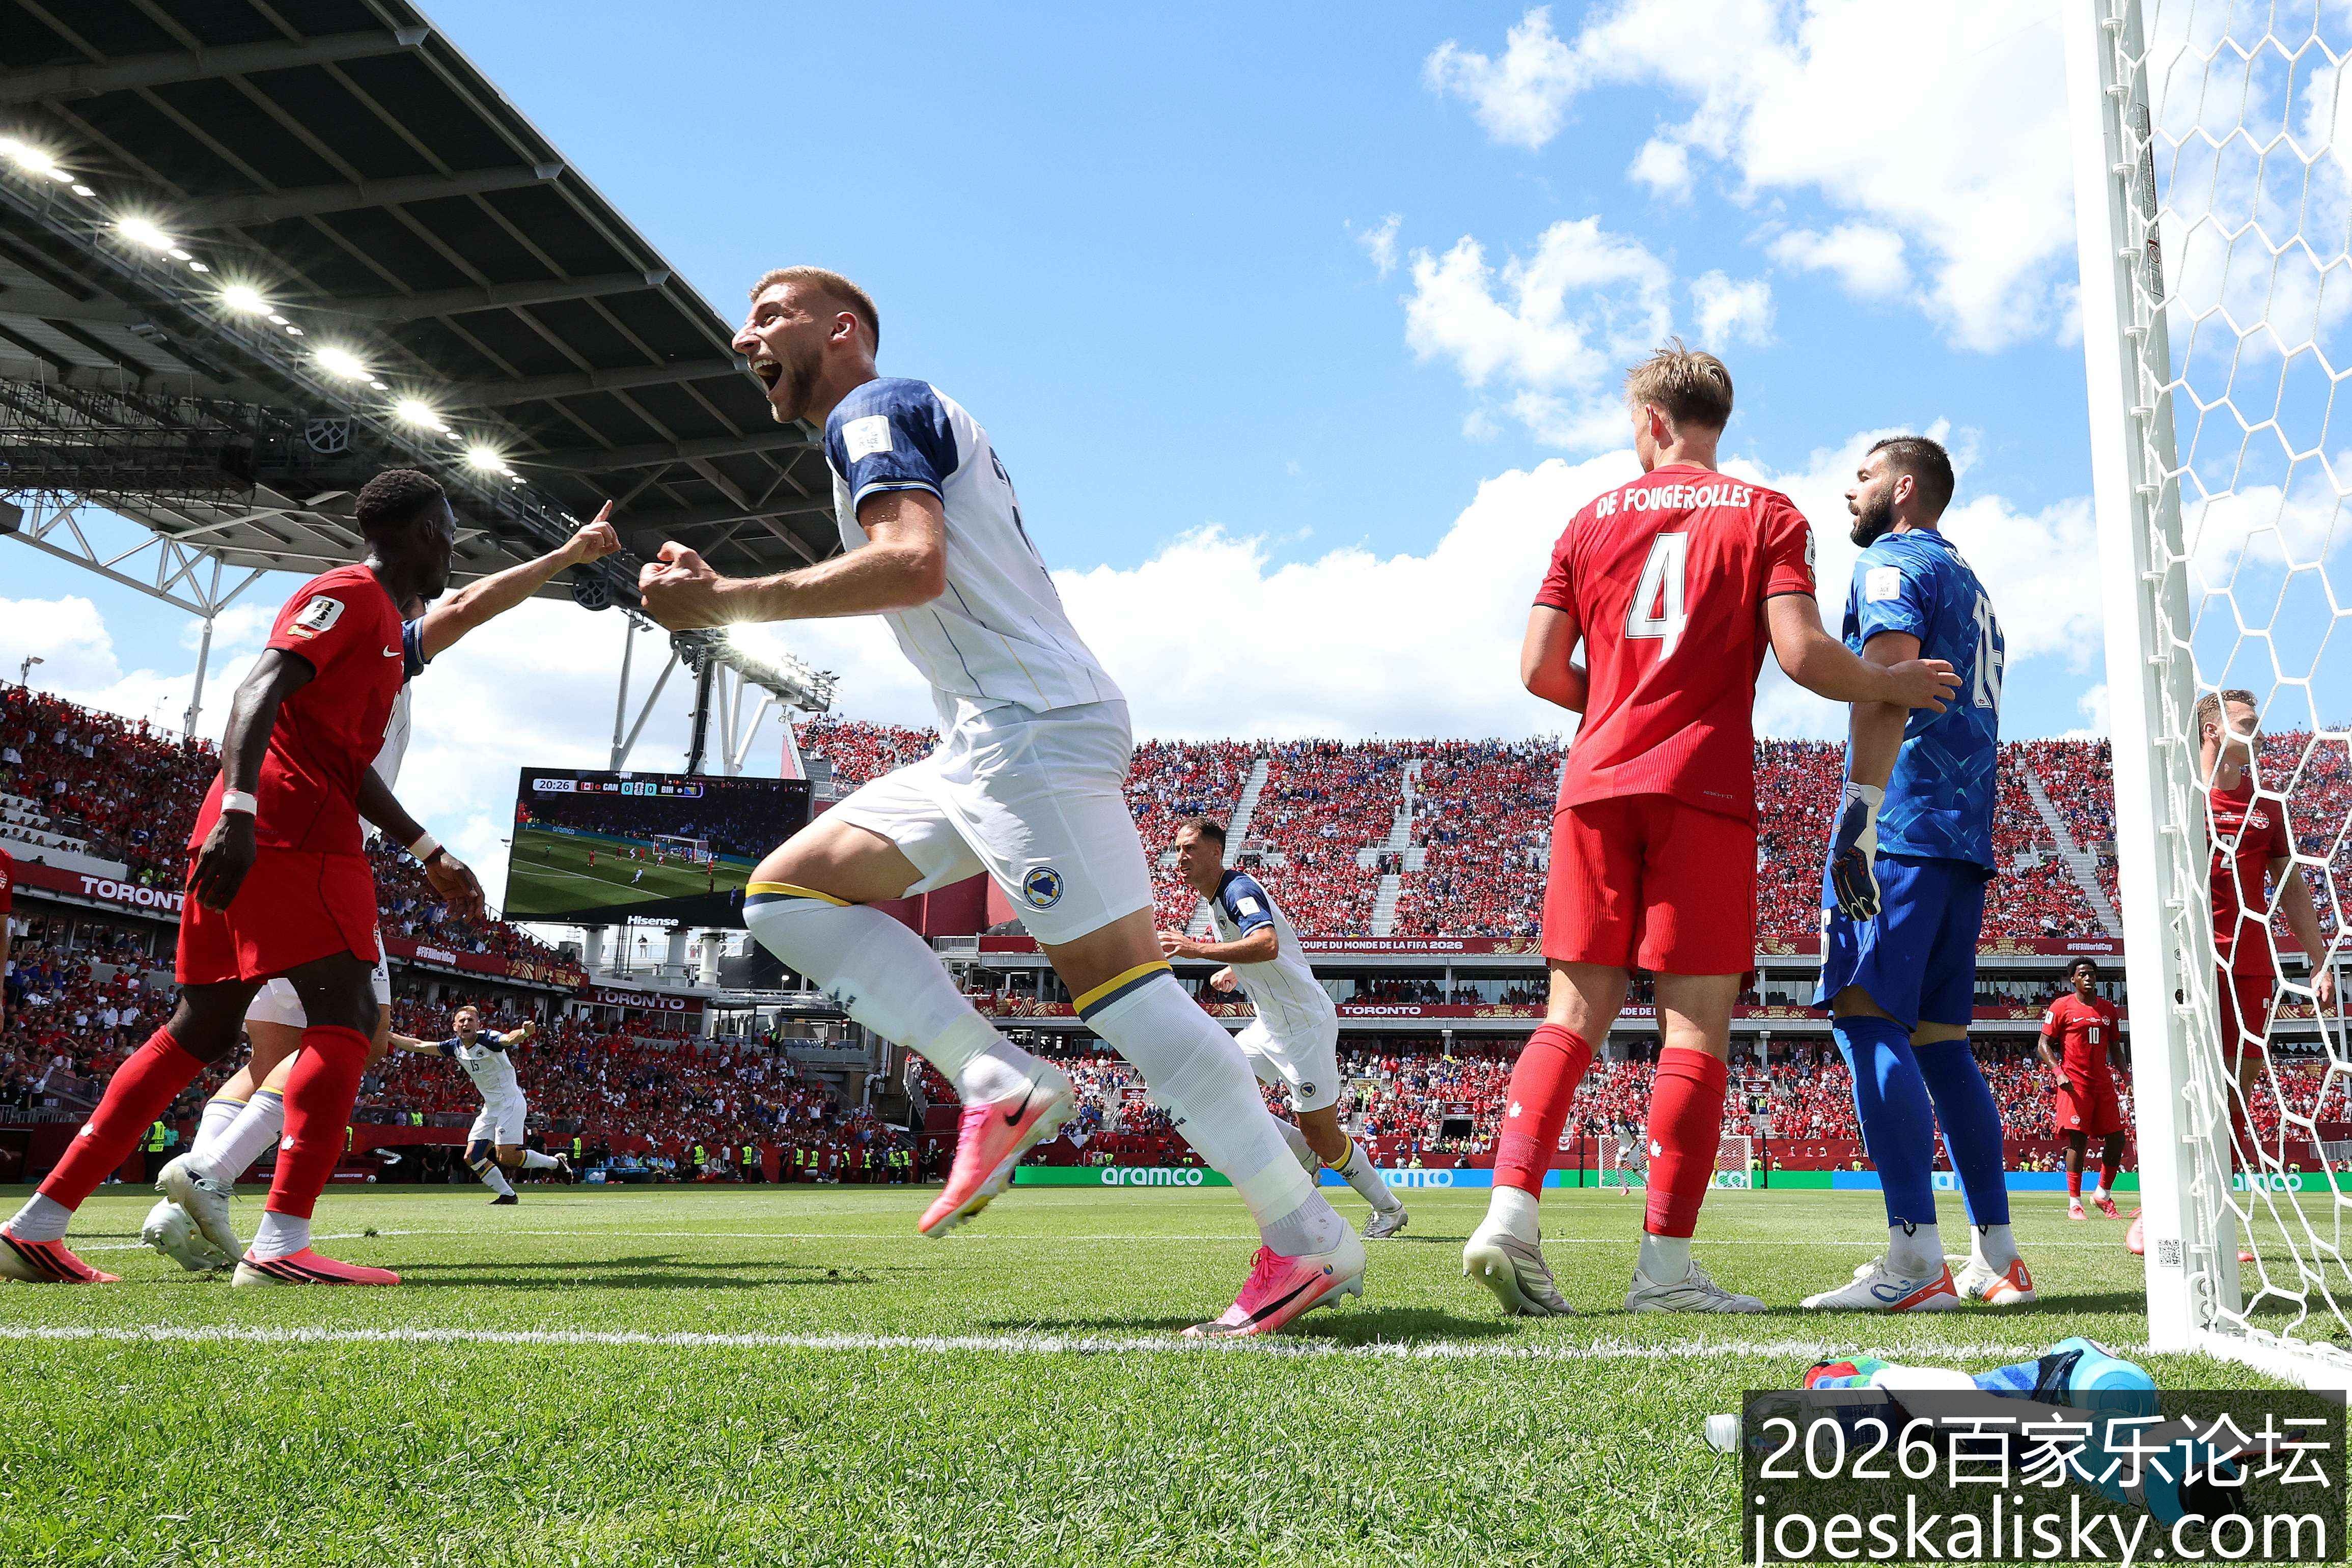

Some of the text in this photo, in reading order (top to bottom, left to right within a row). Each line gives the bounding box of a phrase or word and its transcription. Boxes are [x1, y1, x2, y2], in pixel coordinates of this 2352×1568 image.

[1596, 484, 1753, 519] DE FOUGEROLLES
[1625, 531, 1688, 662] 4
[539, 780, 570, 790] 20:26
[603, 782, 619, 792] CAN
[660, 786, 674, 794] BIH
[2220, 834, 2235, 869] 2
[80, 876, 184, 911] TORONT
[627, 915, 679, 926] Hisense
[1329, 941, 1342, 949] DU
[1344, 941, 1378, 949] MONDE
[1380, 941, 1392, 949] DE
[1429, 941, 1463, 950] 2026
[2067, 943, 2113, 951] #FIFAWorldCup
[2326, 938, 2352, 946] WOR
[595, 990, 685, 1010] TORONTO
[1342, 1006, 1421, 1015] TORONTO
[2088, 1027, 2099, 1044] 10
[469, 1060, 480, 1072] 15
[1101, 1167, 1203, 1186] aramco
[1379, 1169, 1454, 1187] ramco
[2233, 1173, 2303, 1191] amco
